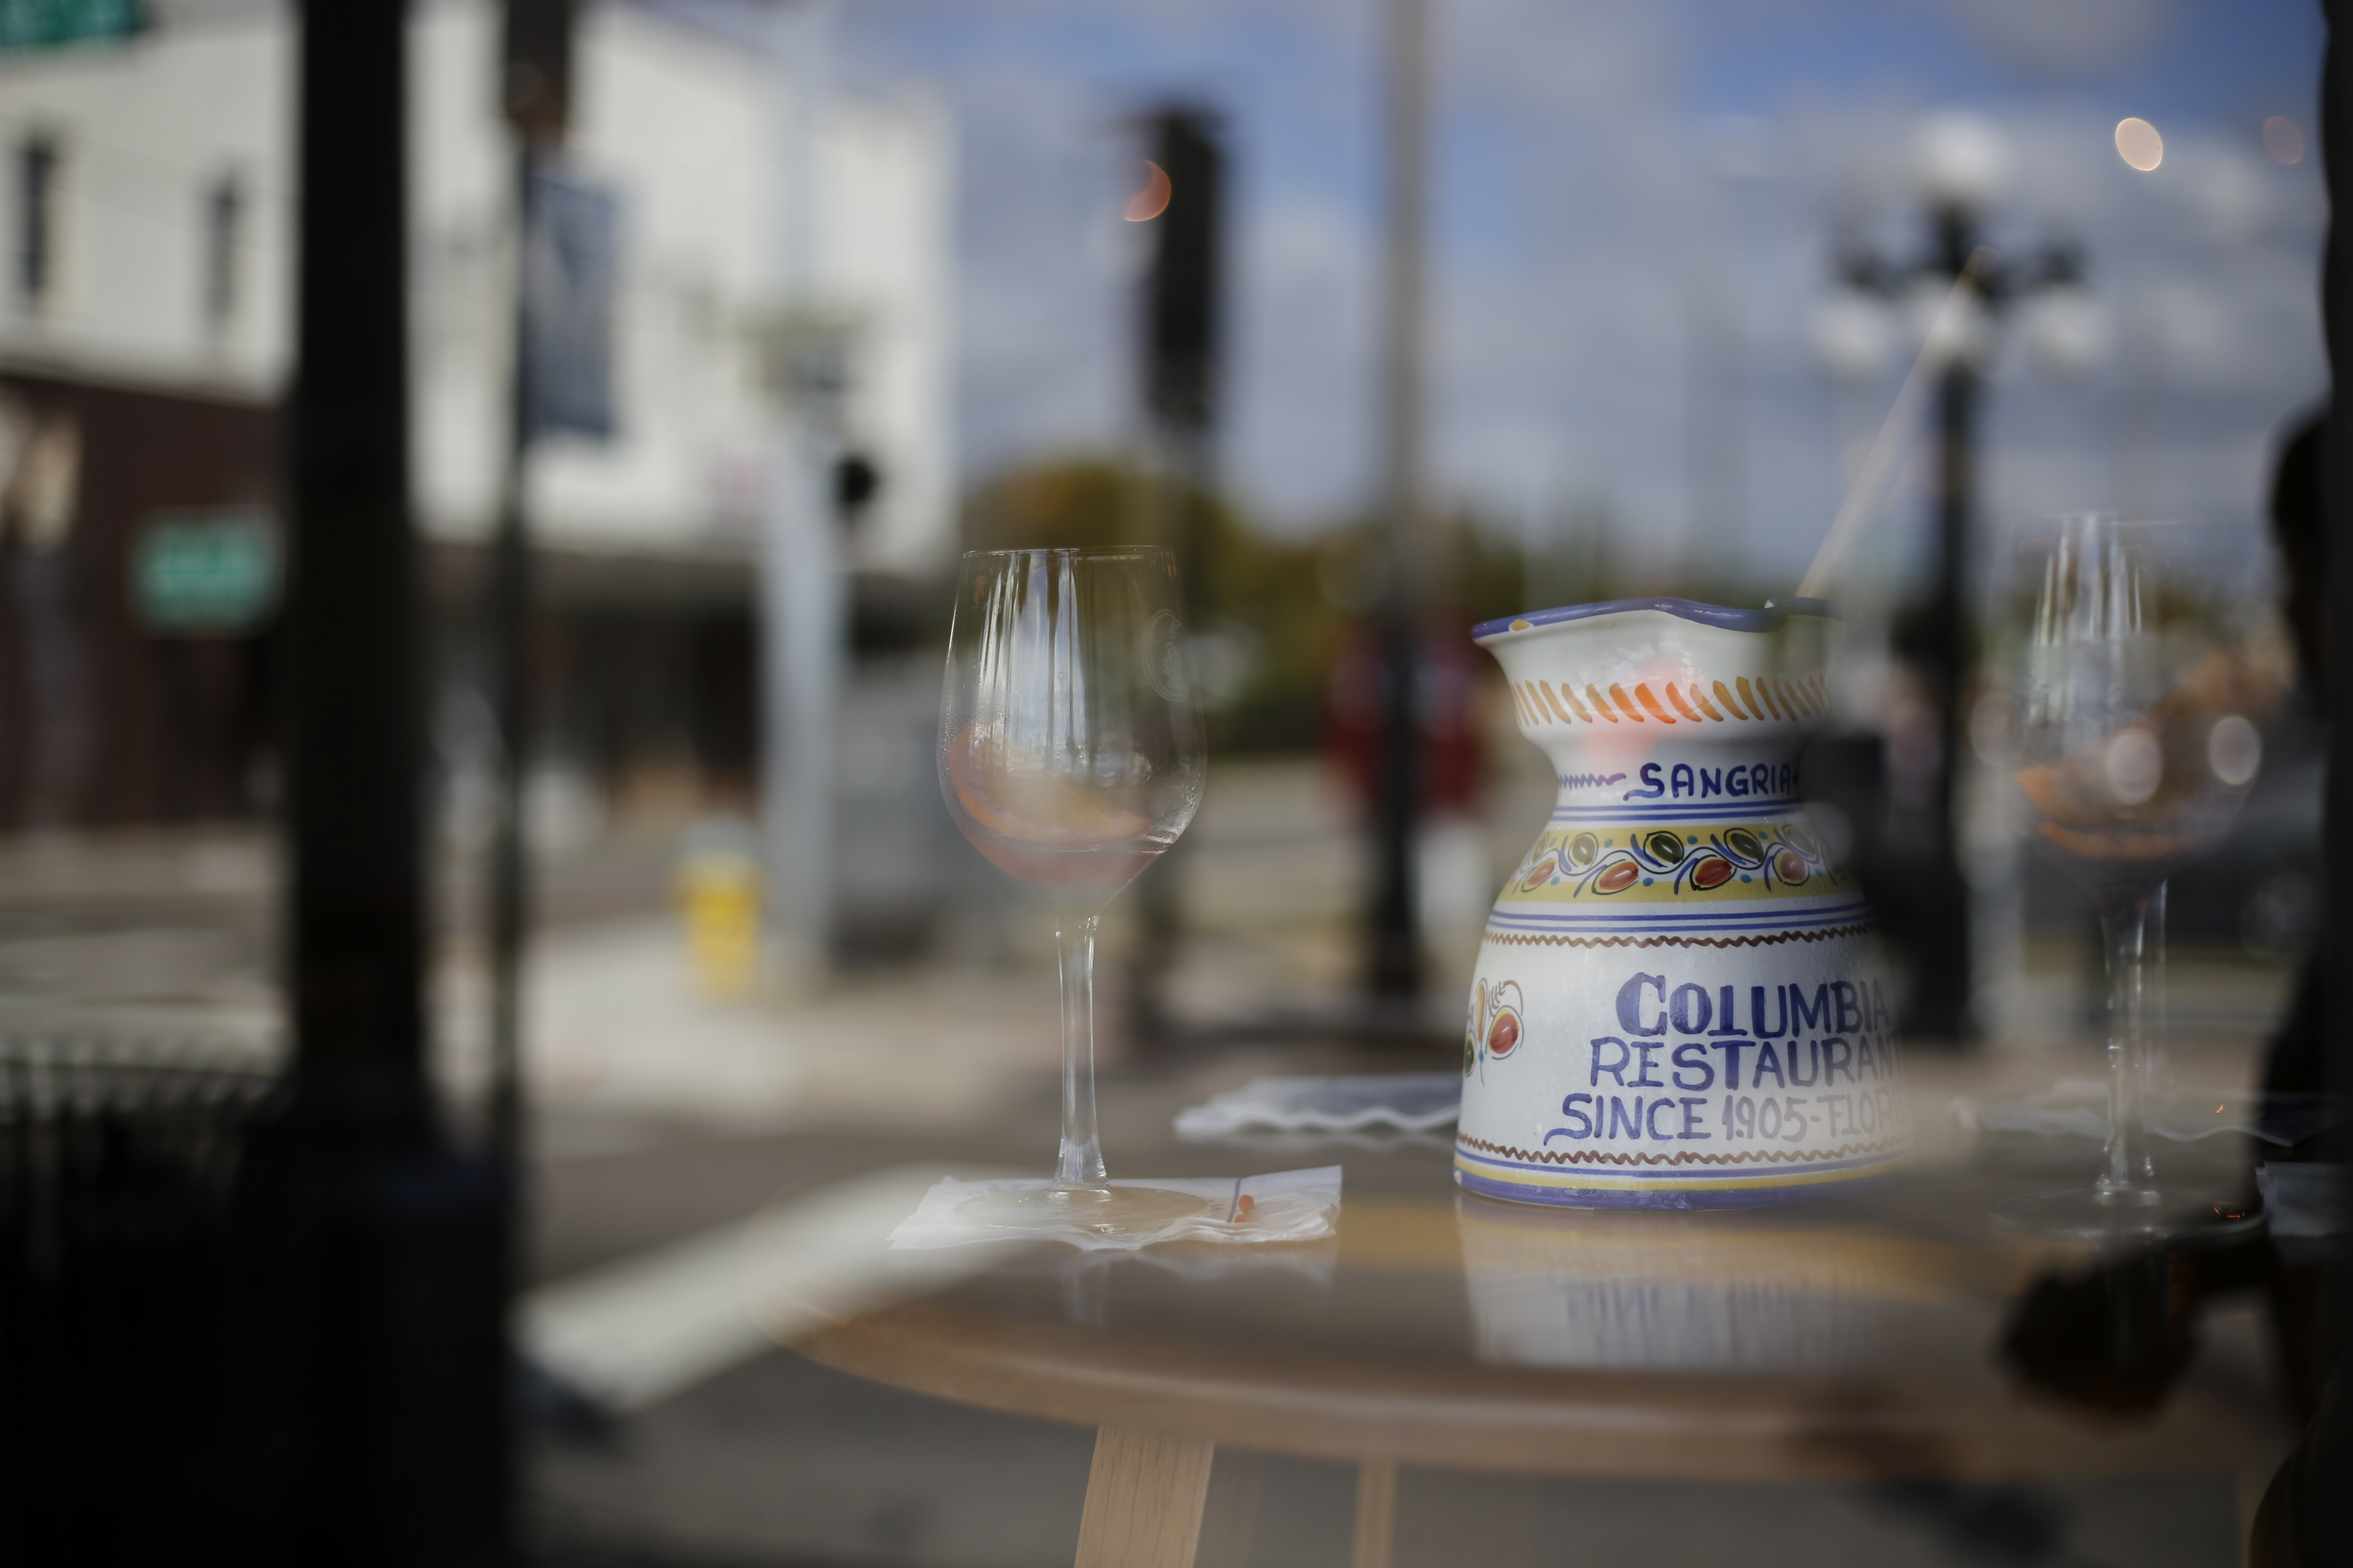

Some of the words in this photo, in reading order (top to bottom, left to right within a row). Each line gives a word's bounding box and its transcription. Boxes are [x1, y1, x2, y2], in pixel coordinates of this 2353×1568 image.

[1622, 762, 1790, 801] SANGRIA
[1615, 972, 1890, 1039] COLUMBIA
[1543, 1093, 1712, 1146] SINCE
